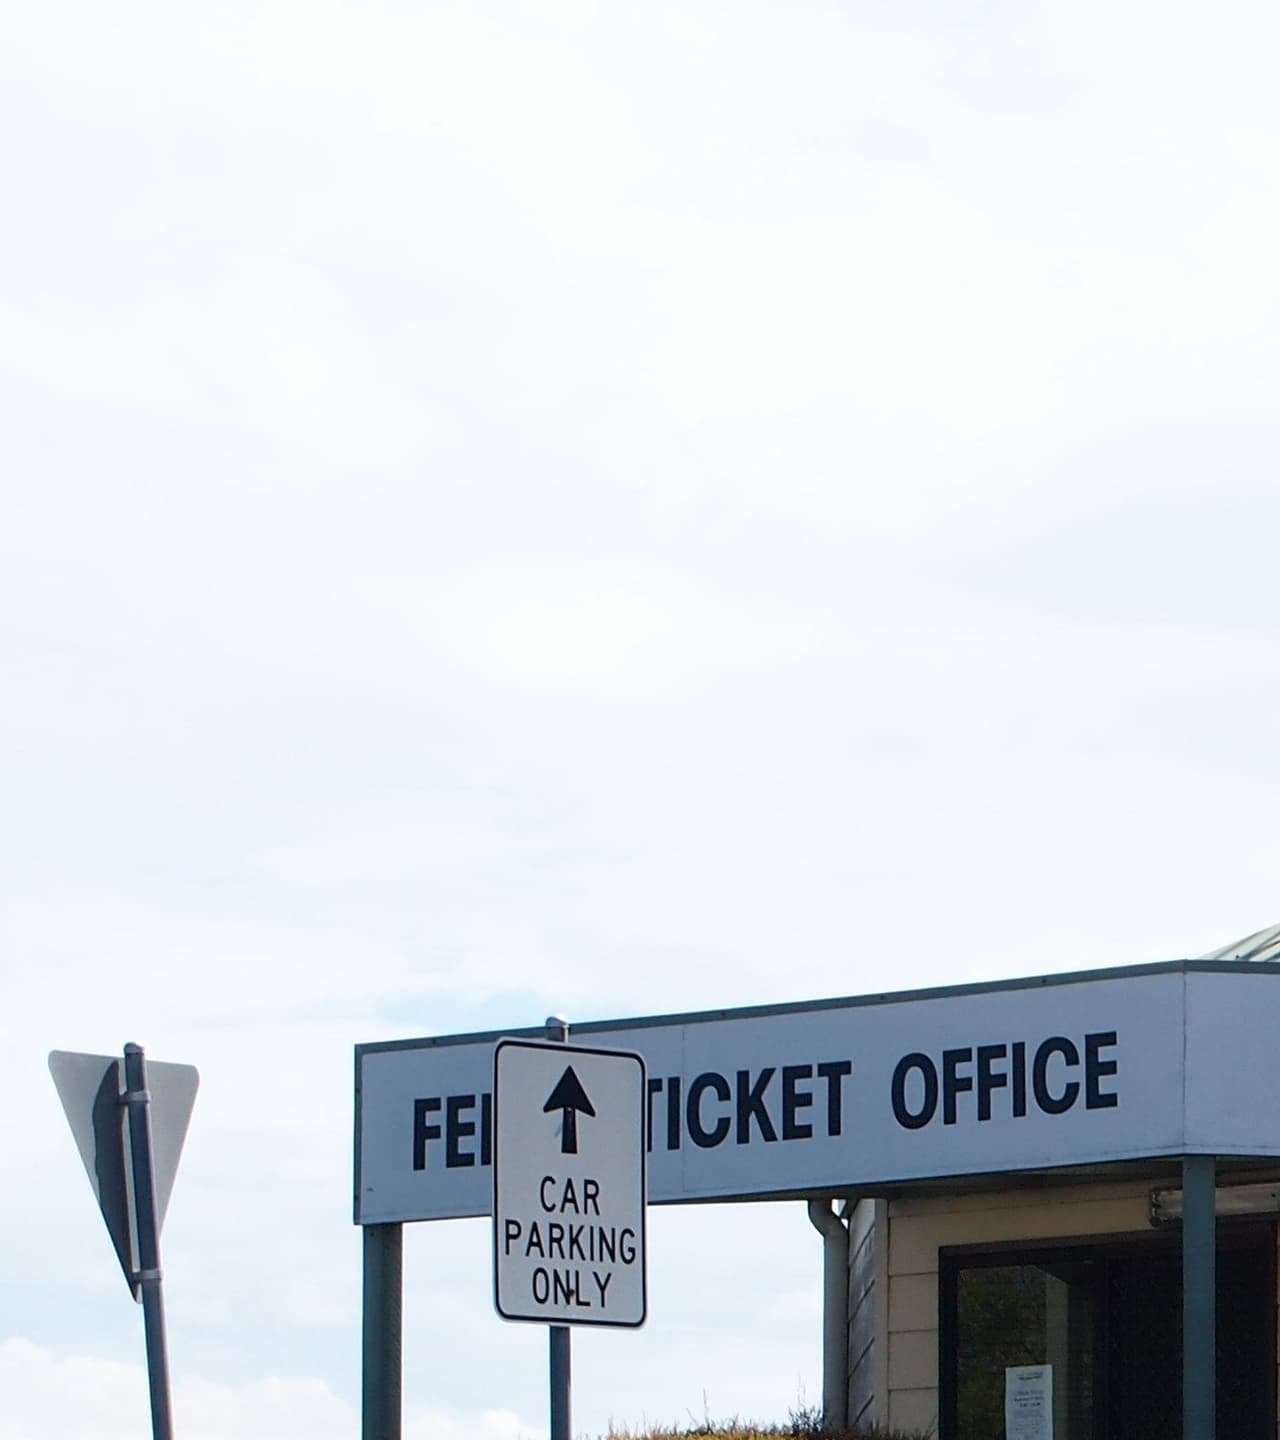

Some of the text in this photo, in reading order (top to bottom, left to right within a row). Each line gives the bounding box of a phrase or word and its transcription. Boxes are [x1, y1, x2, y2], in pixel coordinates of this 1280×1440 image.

[890, 1030, 1119, 1131] OFFICE
[540, 1175, 600, 1216] CAR
[505, 1218, 636, 1265] PARKING
[532, 1267, 612, 1308] ONLY
